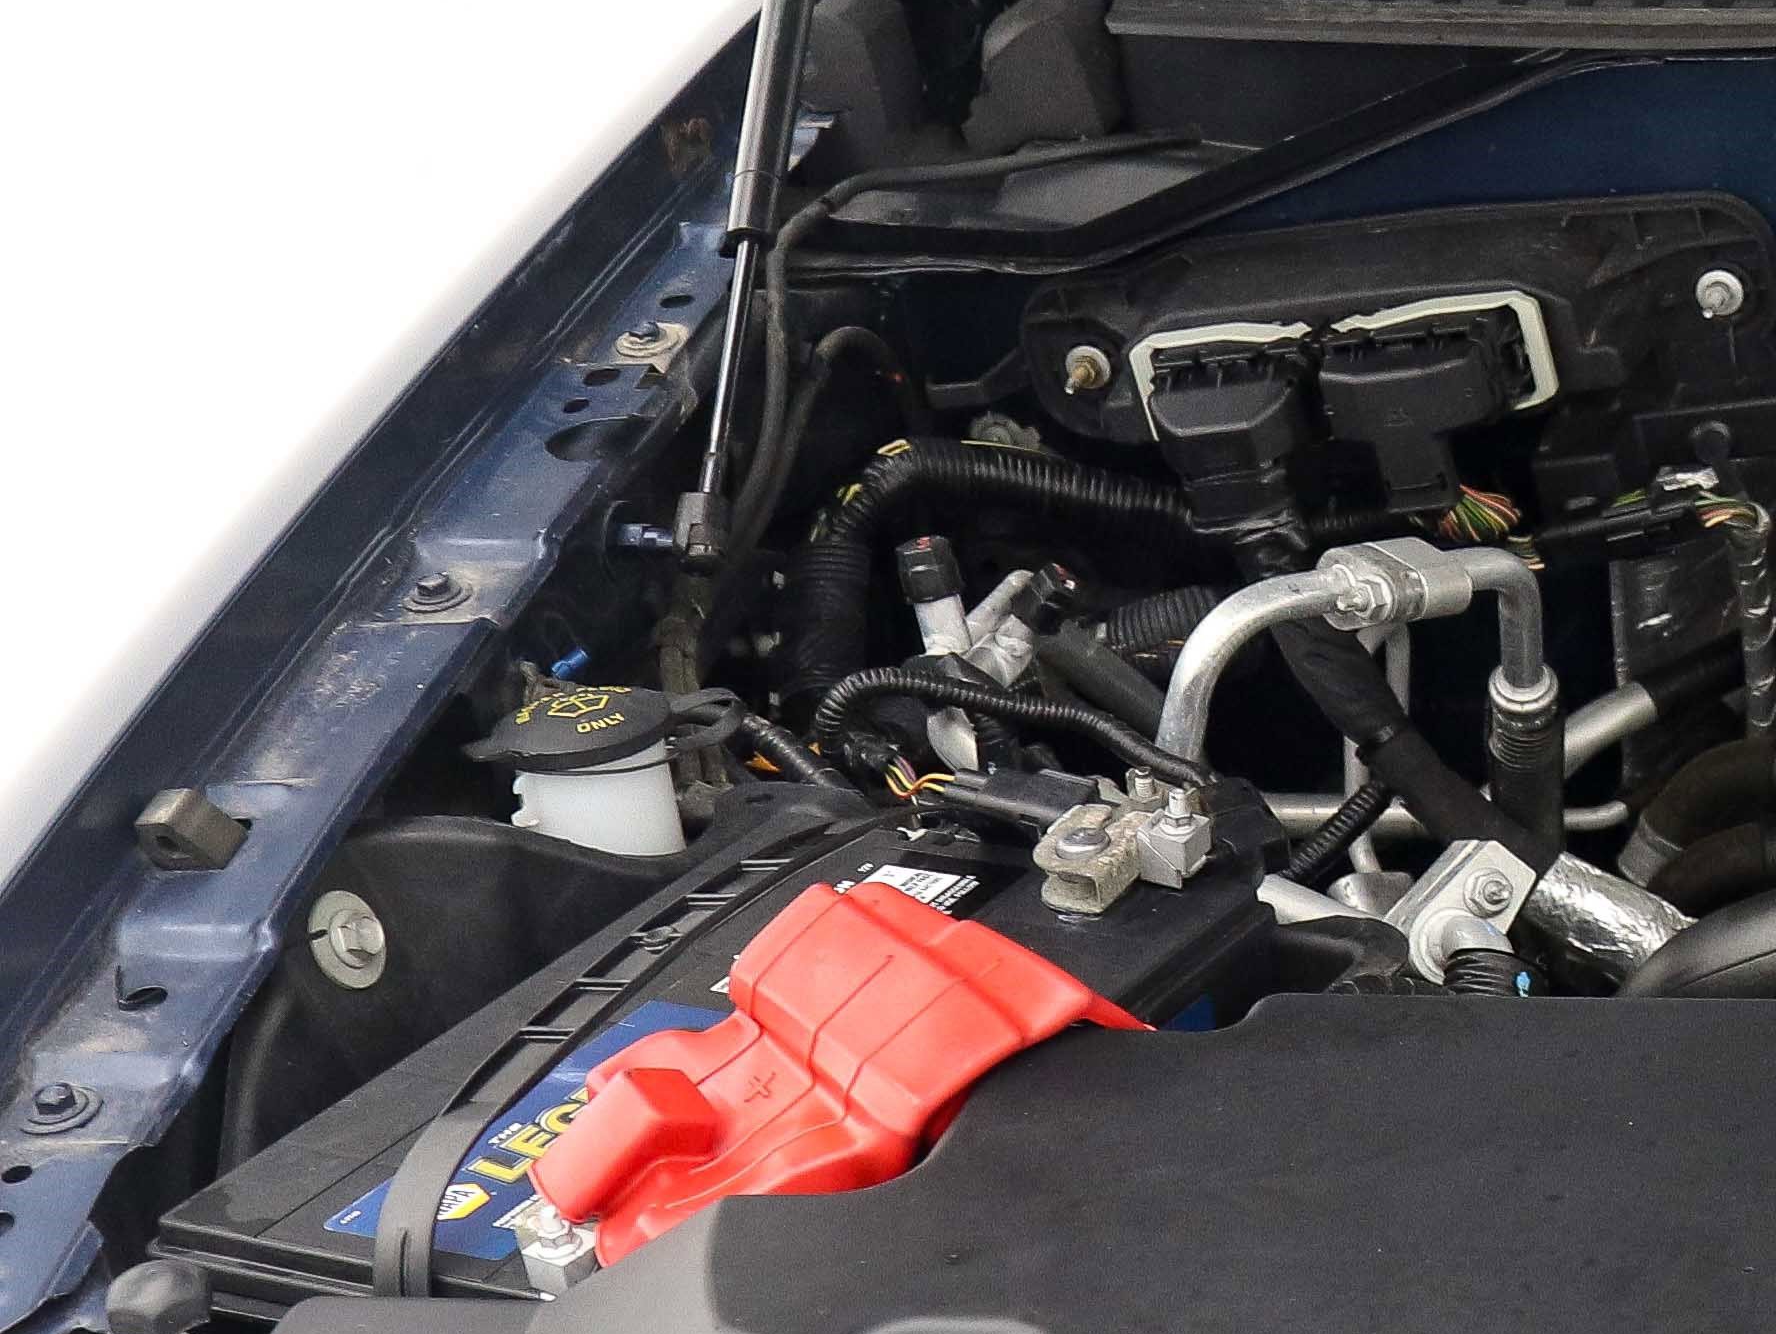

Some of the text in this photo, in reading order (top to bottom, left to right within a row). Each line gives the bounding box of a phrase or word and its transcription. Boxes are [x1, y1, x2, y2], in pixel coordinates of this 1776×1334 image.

[576, 712, 625, 733] ONLY
[465, 1087, 589, 1185] LEG
[488, 1122, 522, 1144] THE
